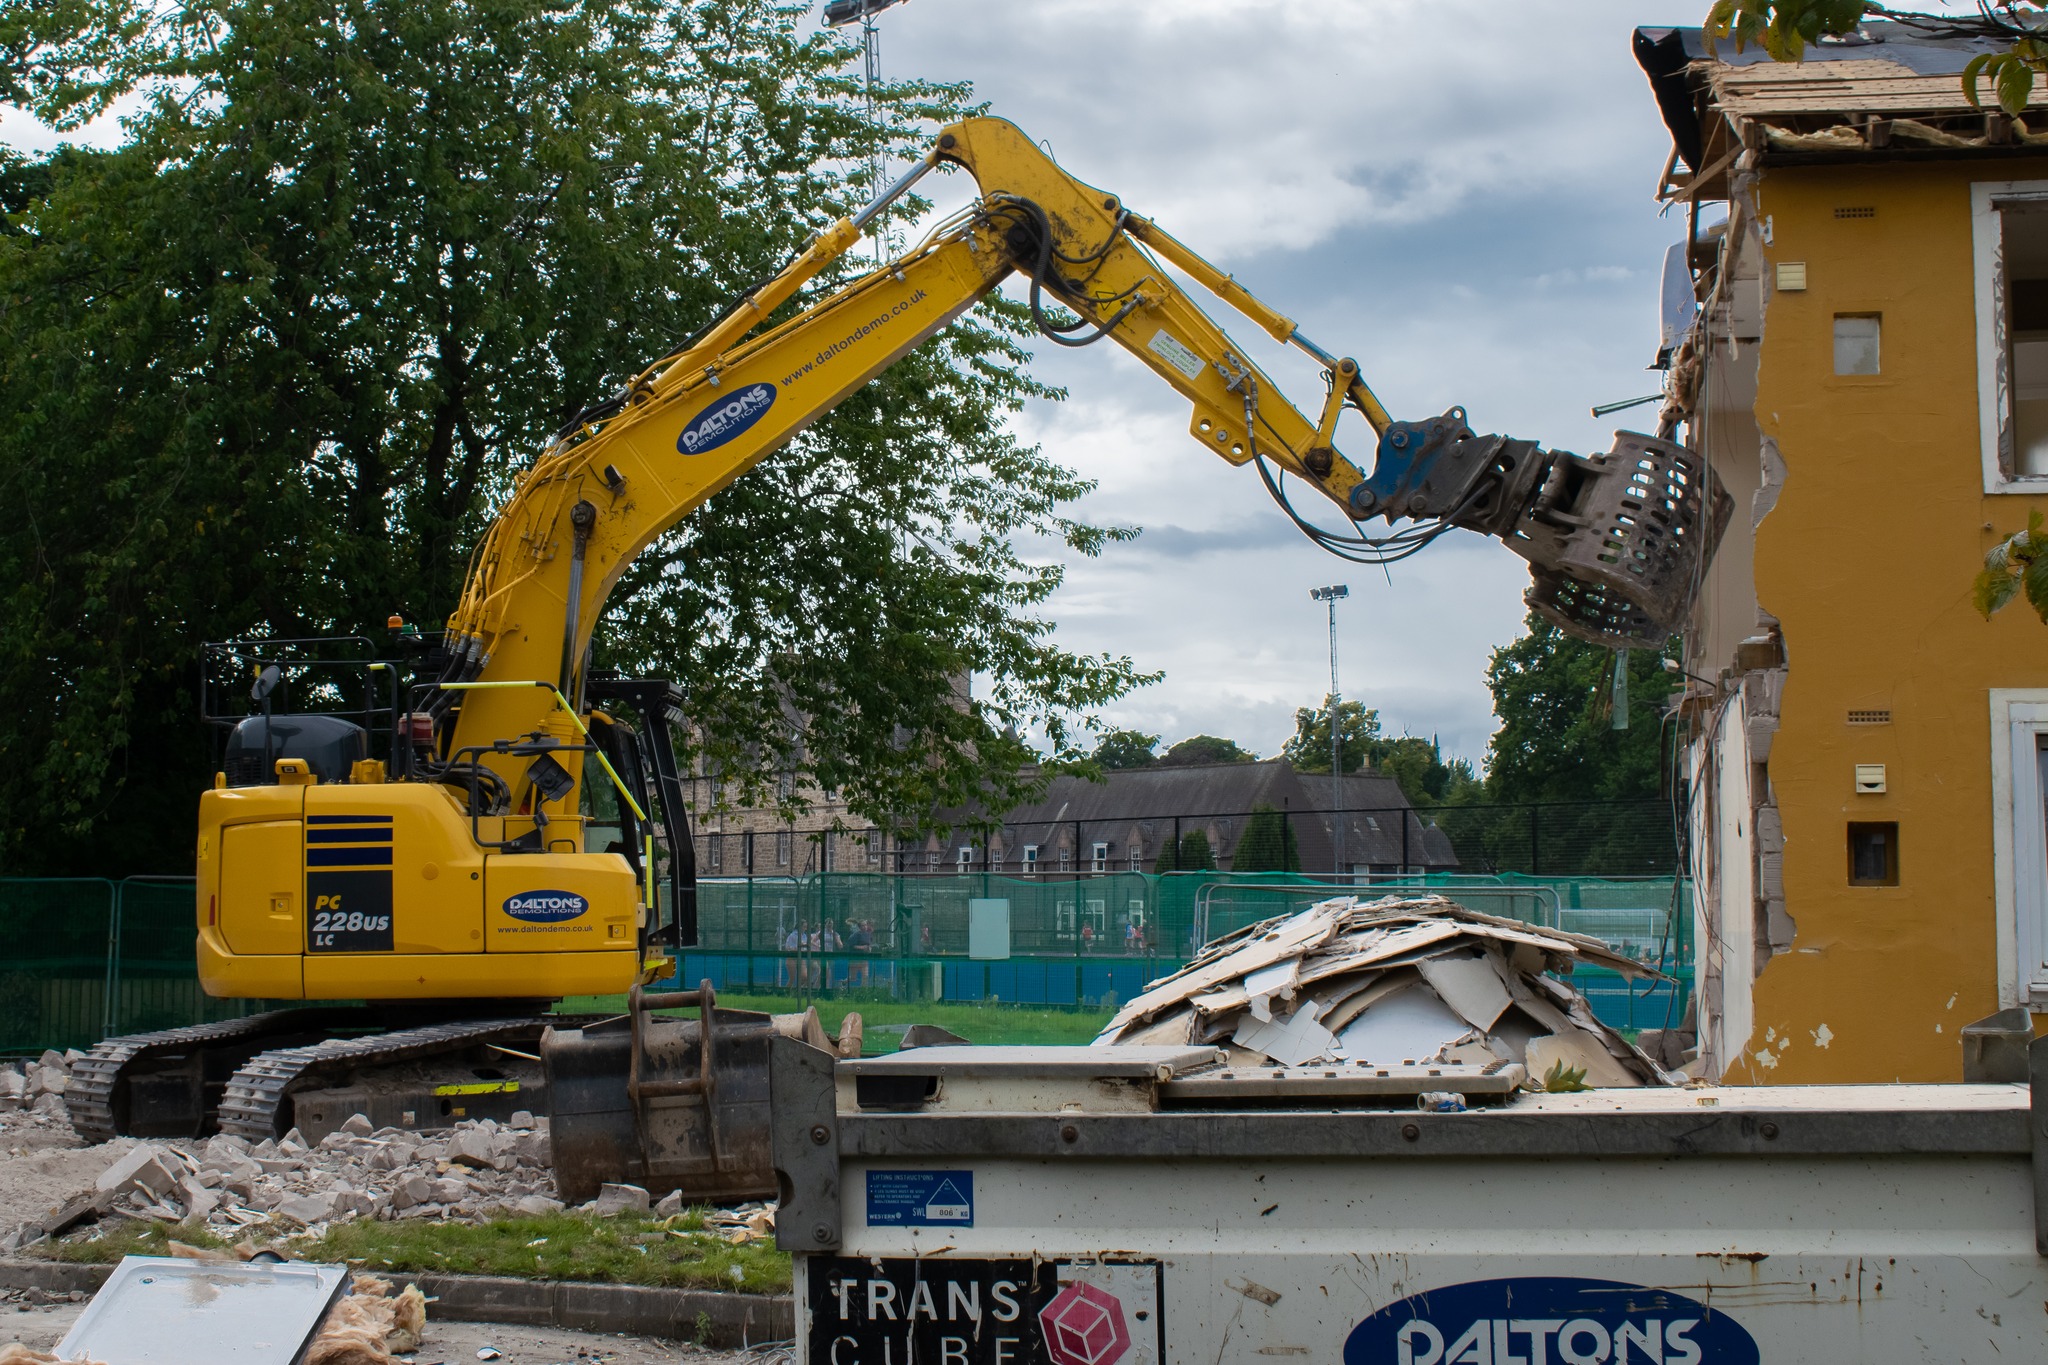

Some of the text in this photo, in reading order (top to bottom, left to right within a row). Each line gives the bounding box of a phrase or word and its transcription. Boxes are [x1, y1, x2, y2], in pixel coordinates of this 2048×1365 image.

[781, 288, 927, 387] www.daltondemo.co.uk
[682, 385, 768, 447] DALTONS
[689, 397, 770, 453] DEMOLITIONS
[315, 895, 341, 910] PC
[509, 897, 582, 909] DALTONS
[316, 934, 334, 946] LC
[498, 925, 593, 933] www.daltondemo.co.uk
[912, 1207, 926, 1217] SWL
[830, 1279, 1021, 1322] TRANS
[1397, 1319, 1702, 1365] DALTONS
